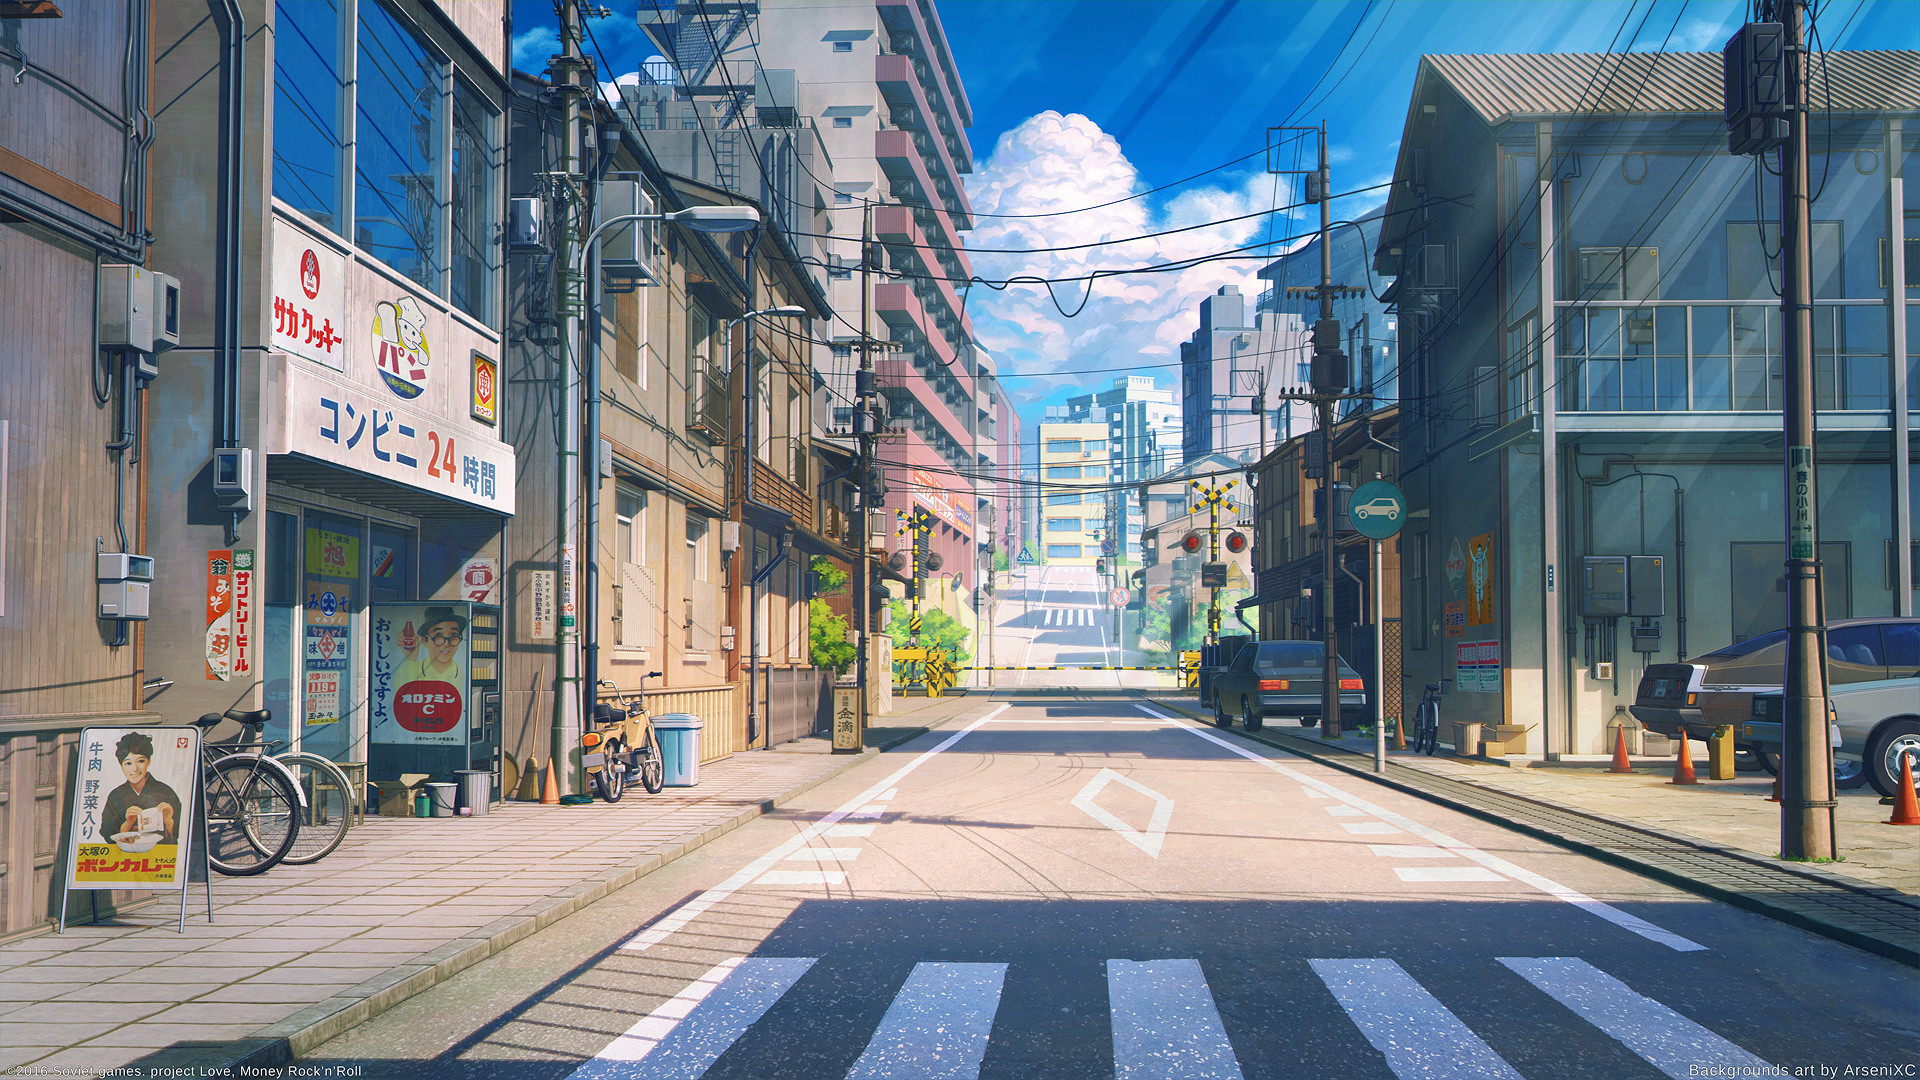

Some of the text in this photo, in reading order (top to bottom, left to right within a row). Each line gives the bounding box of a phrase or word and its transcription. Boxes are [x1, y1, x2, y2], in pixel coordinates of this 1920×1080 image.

[274, 296, 342, 354] サカ クッキー
[378, 340, 427, 380] パン
[320, 397, 496, 500] コンビニ 24 時間
[234, 572, 249, 672] サントリービール
[401, 694, 456, 704] オロナミン
[422, 704, 435, 715] C
[81, 741, 104, 840] 牛肉 野菜入り
[77, 858, 175, 873] ボンカレー
[79, 846, 110, 857] 大塚の
